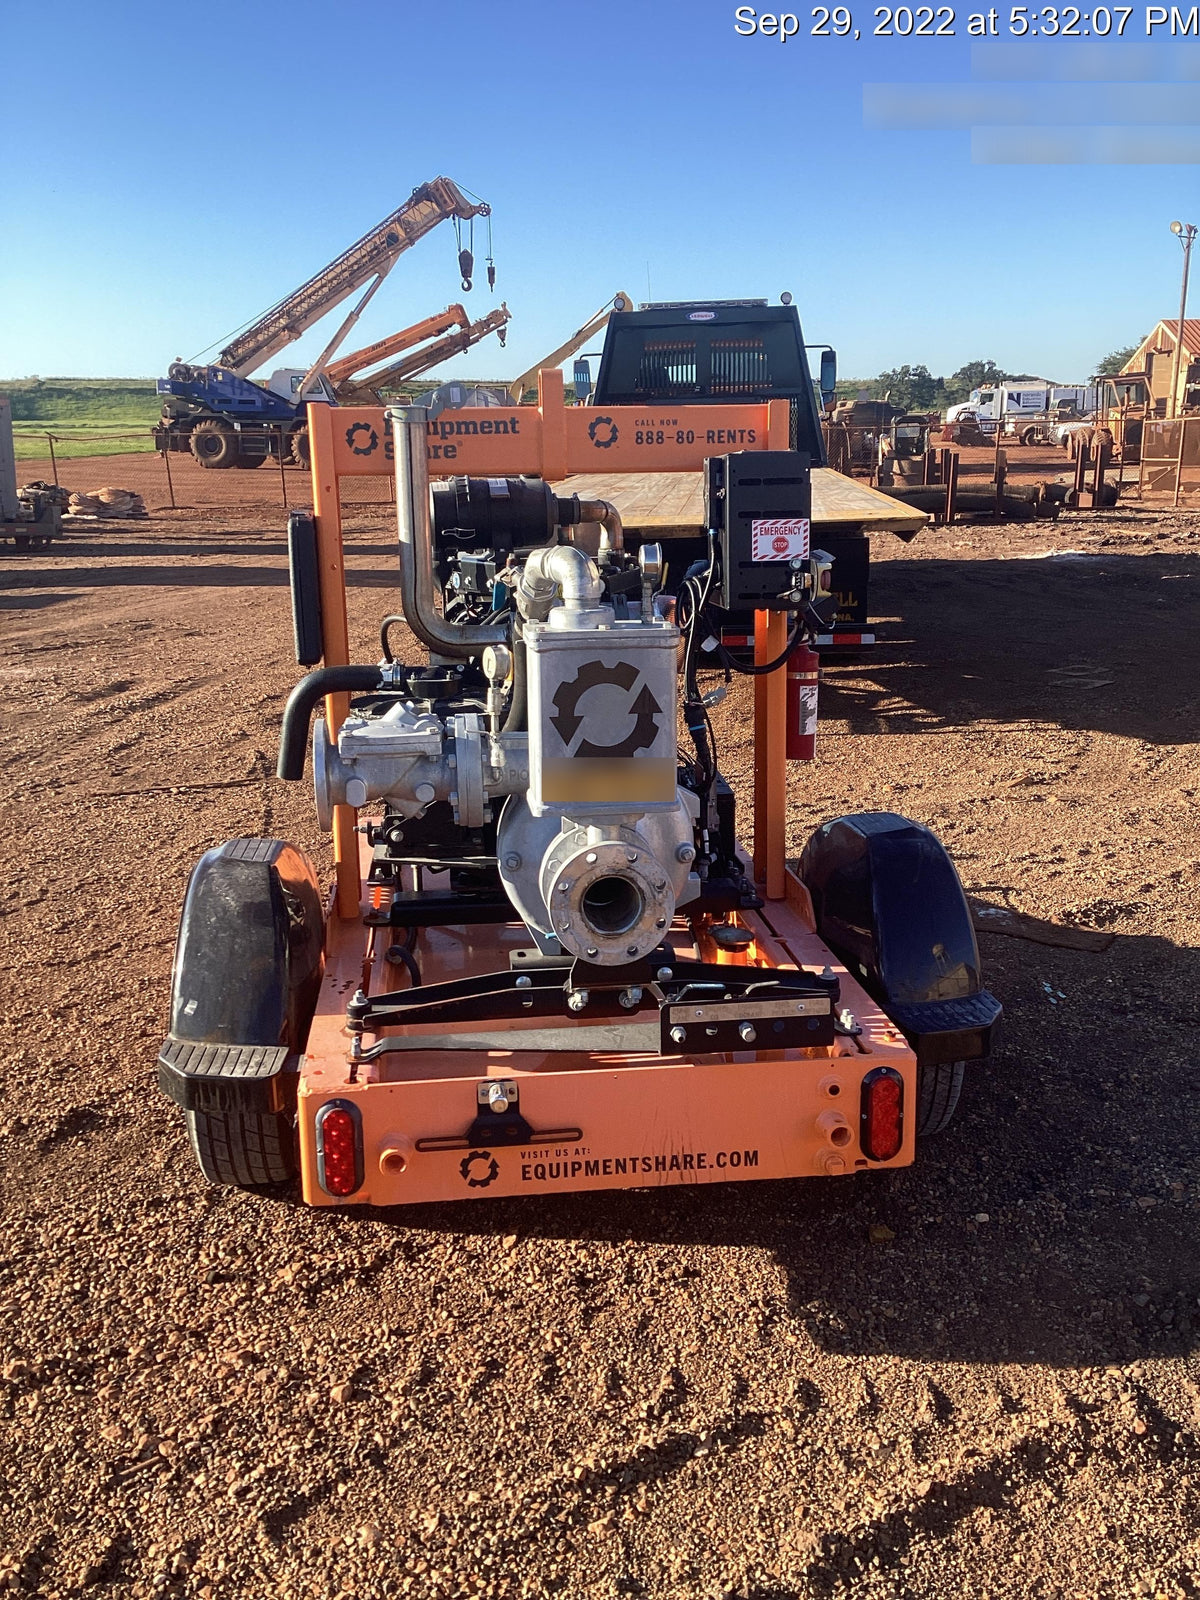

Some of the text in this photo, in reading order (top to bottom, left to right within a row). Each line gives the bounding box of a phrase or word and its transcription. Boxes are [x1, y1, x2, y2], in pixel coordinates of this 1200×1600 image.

[634, 418, 679, 427] CALL NOW
[634, 428, 757, 446] 888-80-RENTS
[759, 526, 801, 536] EMERGENCY
[519, 1147, 592, 1160] VISIT US AT:
[521, 1150, 759, 1181] EQUIPMENTSHARE.COM
